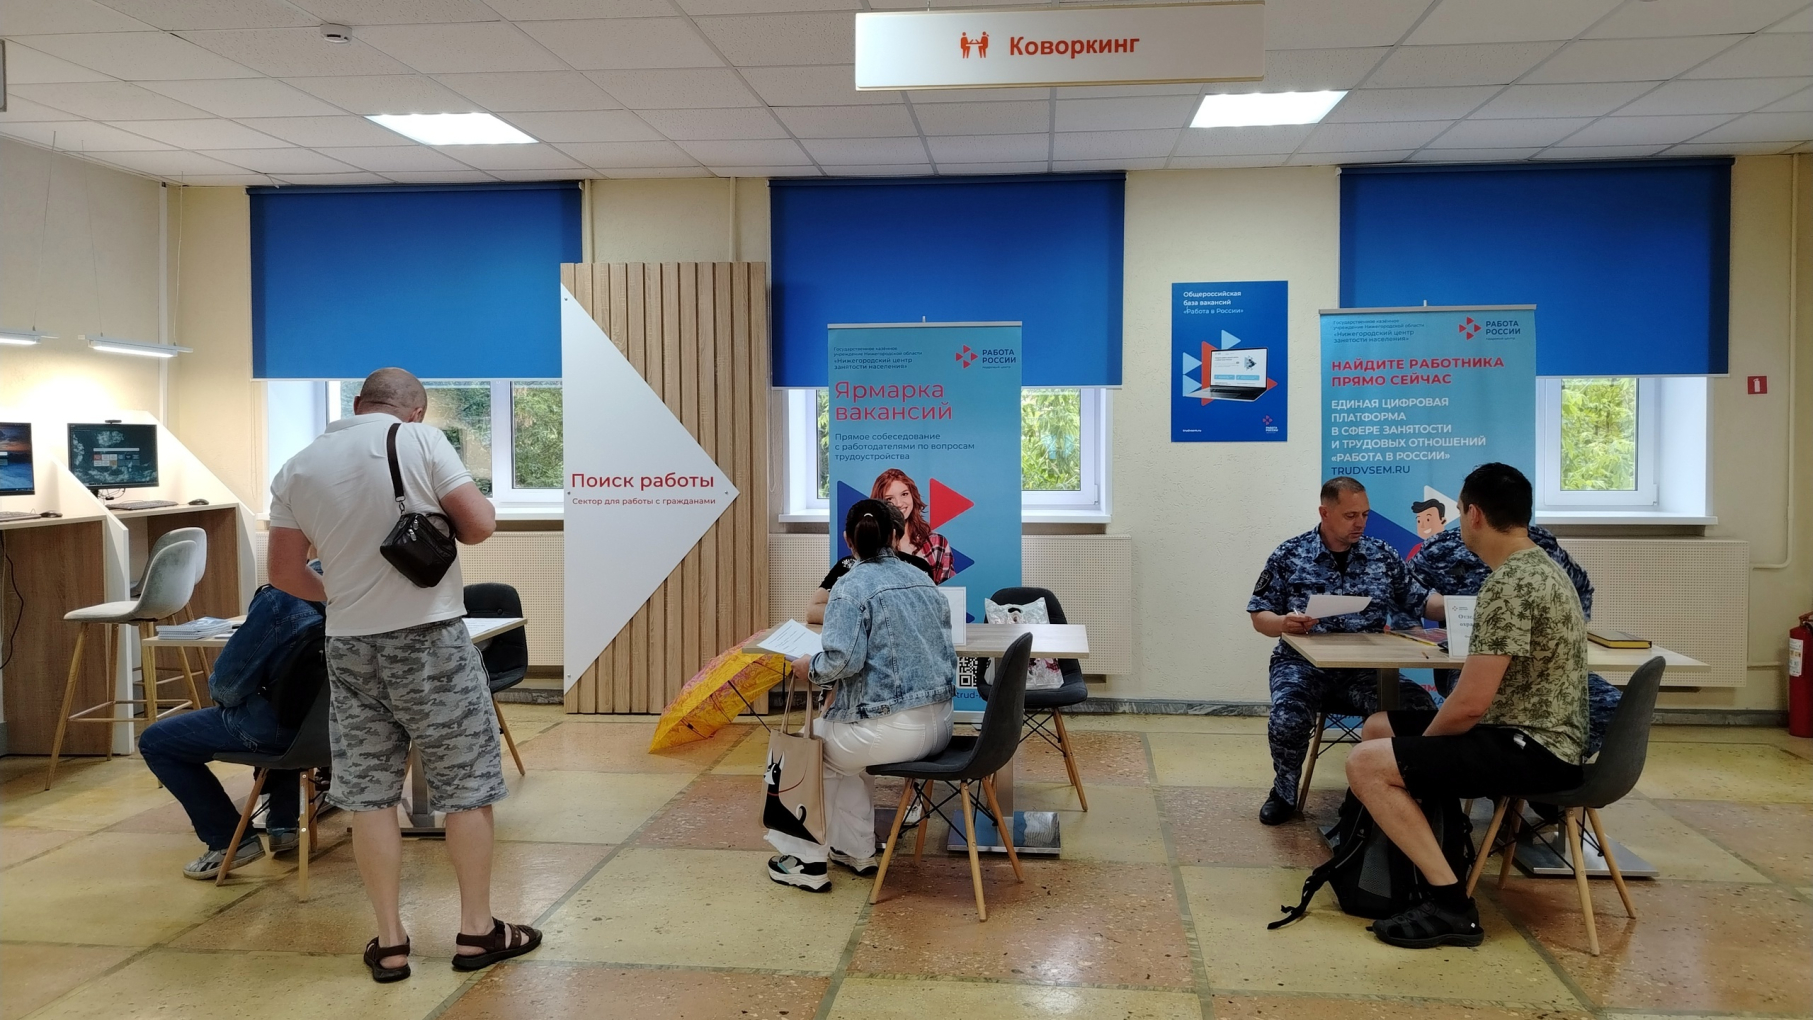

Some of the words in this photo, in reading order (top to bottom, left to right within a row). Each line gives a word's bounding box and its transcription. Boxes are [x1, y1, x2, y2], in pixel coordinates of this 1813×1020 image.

[1009, 35, 1140, 59] Коворкинг
[1331, 358, 1405, 371] НАЙДИТЕ
[1409, 357, 1505, 370] РАБОТНИКА
[1331, 375, 1386, 387] ПРЯМО
[1390, 372, 1452, 385] СЕЙЧАС
[835, 381, 944, 402] Ярмарка
[1331, 399, 1379, 410] ЕДИНАЯ
[1382, 397, 1449, 409] ЦИФРОВАЯ
[836, 401, 952, 421] вакансий
[1331, 412, 1406, 423] ПЛАТФОРМА
[1331, 426, 1339, 436] В
[1341, 425, 1380, 436] СФЕРЕ
[1383, 424, 1452, 434] ЗАНЯТОСТИ
[835, 433, 870, 442] Прямое
[872, 432, 941, 441] собеседование
[1331, 440, 1340, 449] И
[1342, 438, 1406, 450] ТРУДОВЫХ
[1408, 435, 1486, 447] ОТНОШЕНИЙ
[842, 442, 916, 452] работодателями
[931, 443, 975, 451] вопросам
[835, 453, 910, 462] трудоустройства
[1331, 452, 1383, 462] «РАБОТА
[1386, 451, 1394, 461] В
[1396, 451, 1450, 461] РОССИИ»
[1331, 465, 1411, 476] TRUDVSEM.RU
[571, 473, 634, 488] Поиск
[640, 472, 714, 491] работы
[572, 498, 602, 506] Сектор
[604, 498, 620, 506] для
[622, 498, 653, 506] работы
[663, 498, 716, 506] гражданами
[956, 691, 981, 699] trud-
